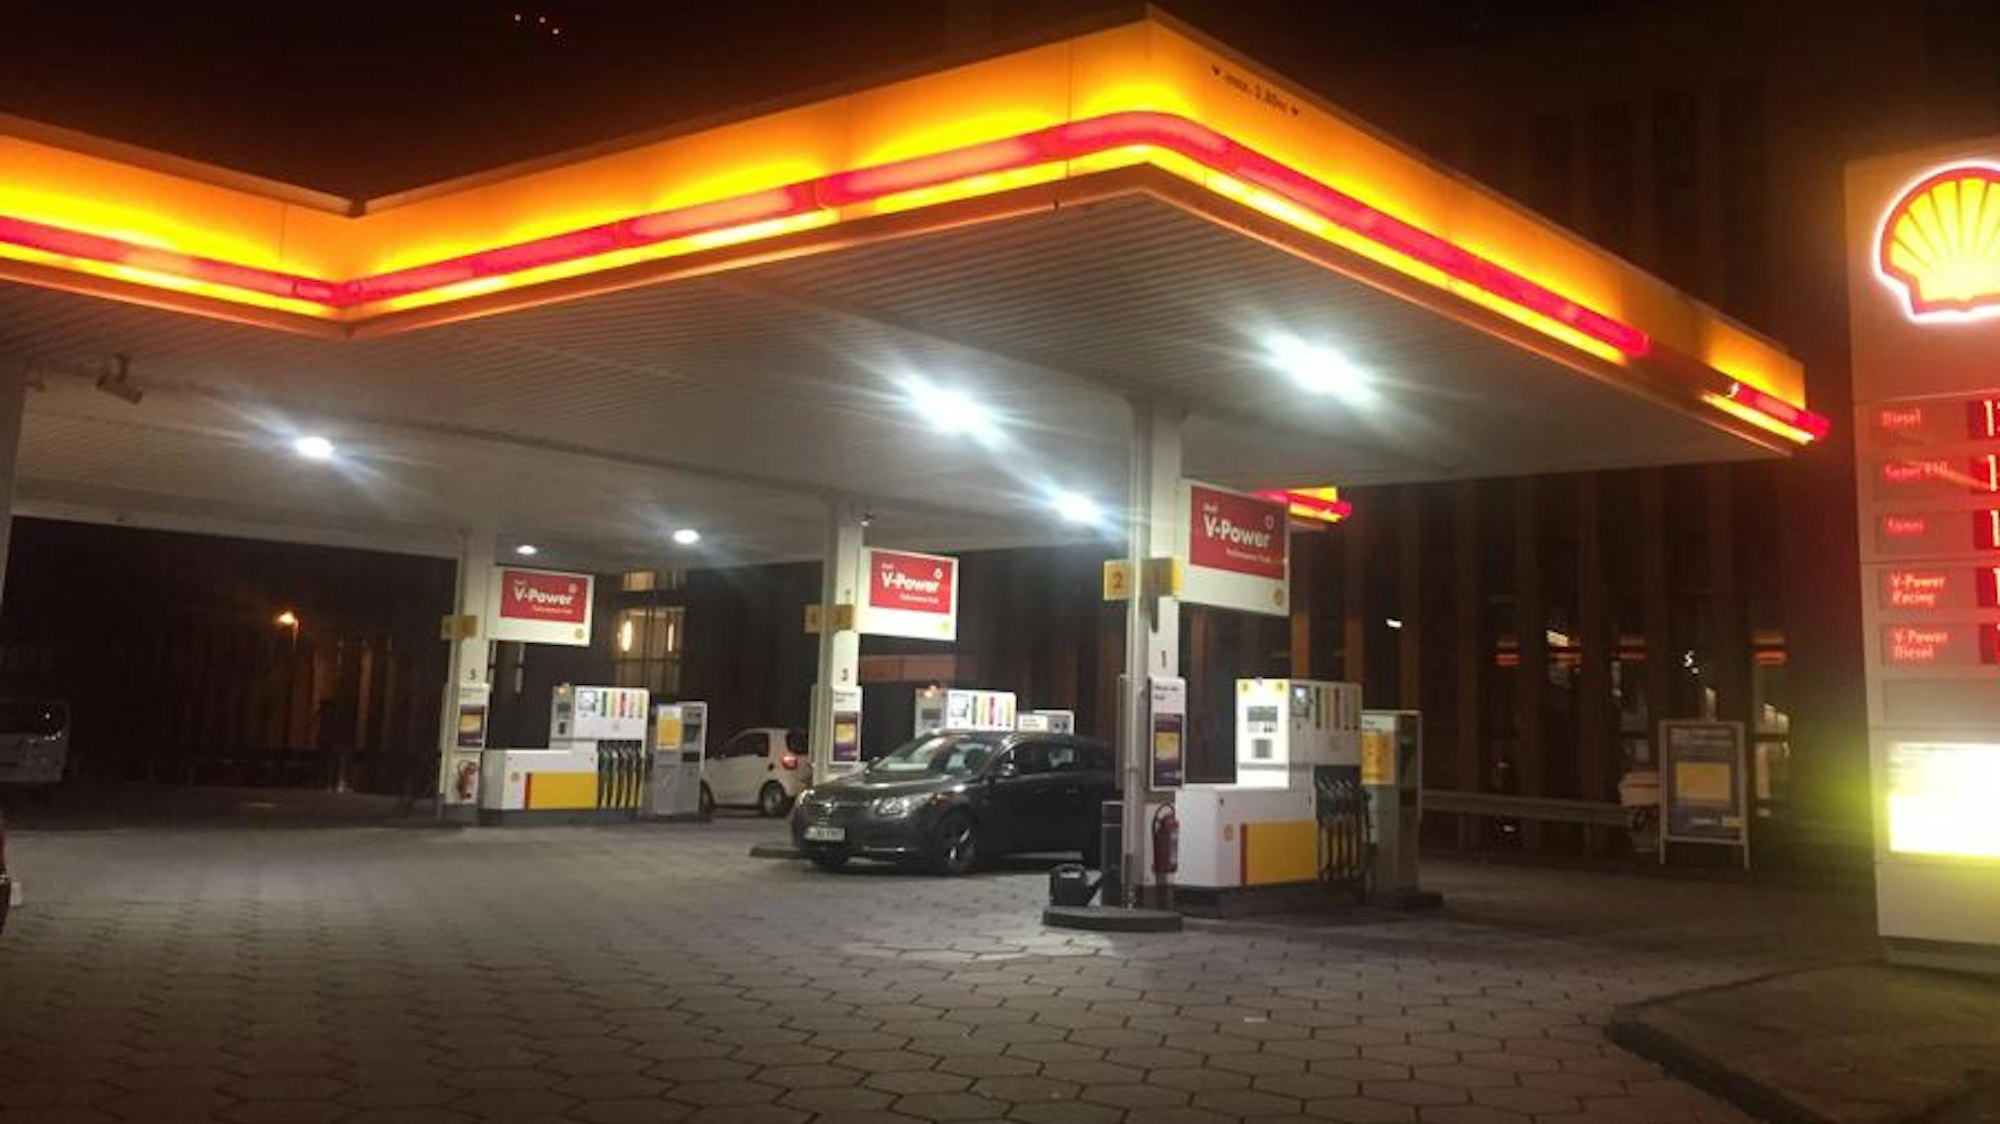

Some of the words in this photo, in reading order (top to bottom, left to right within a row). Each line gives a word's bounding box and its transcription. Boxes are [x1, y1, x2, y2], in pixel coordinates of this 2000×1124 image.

[1883, 408, 1920, 426] Diesel
[1203, 514, 1272, 547] V-Power
[881, 572, 940, 593] V-Power
[1112, 570, 1123, 589] 2
[514, 586, 574, 605] V-Power
[1161, 650, 1167, 668] 1
